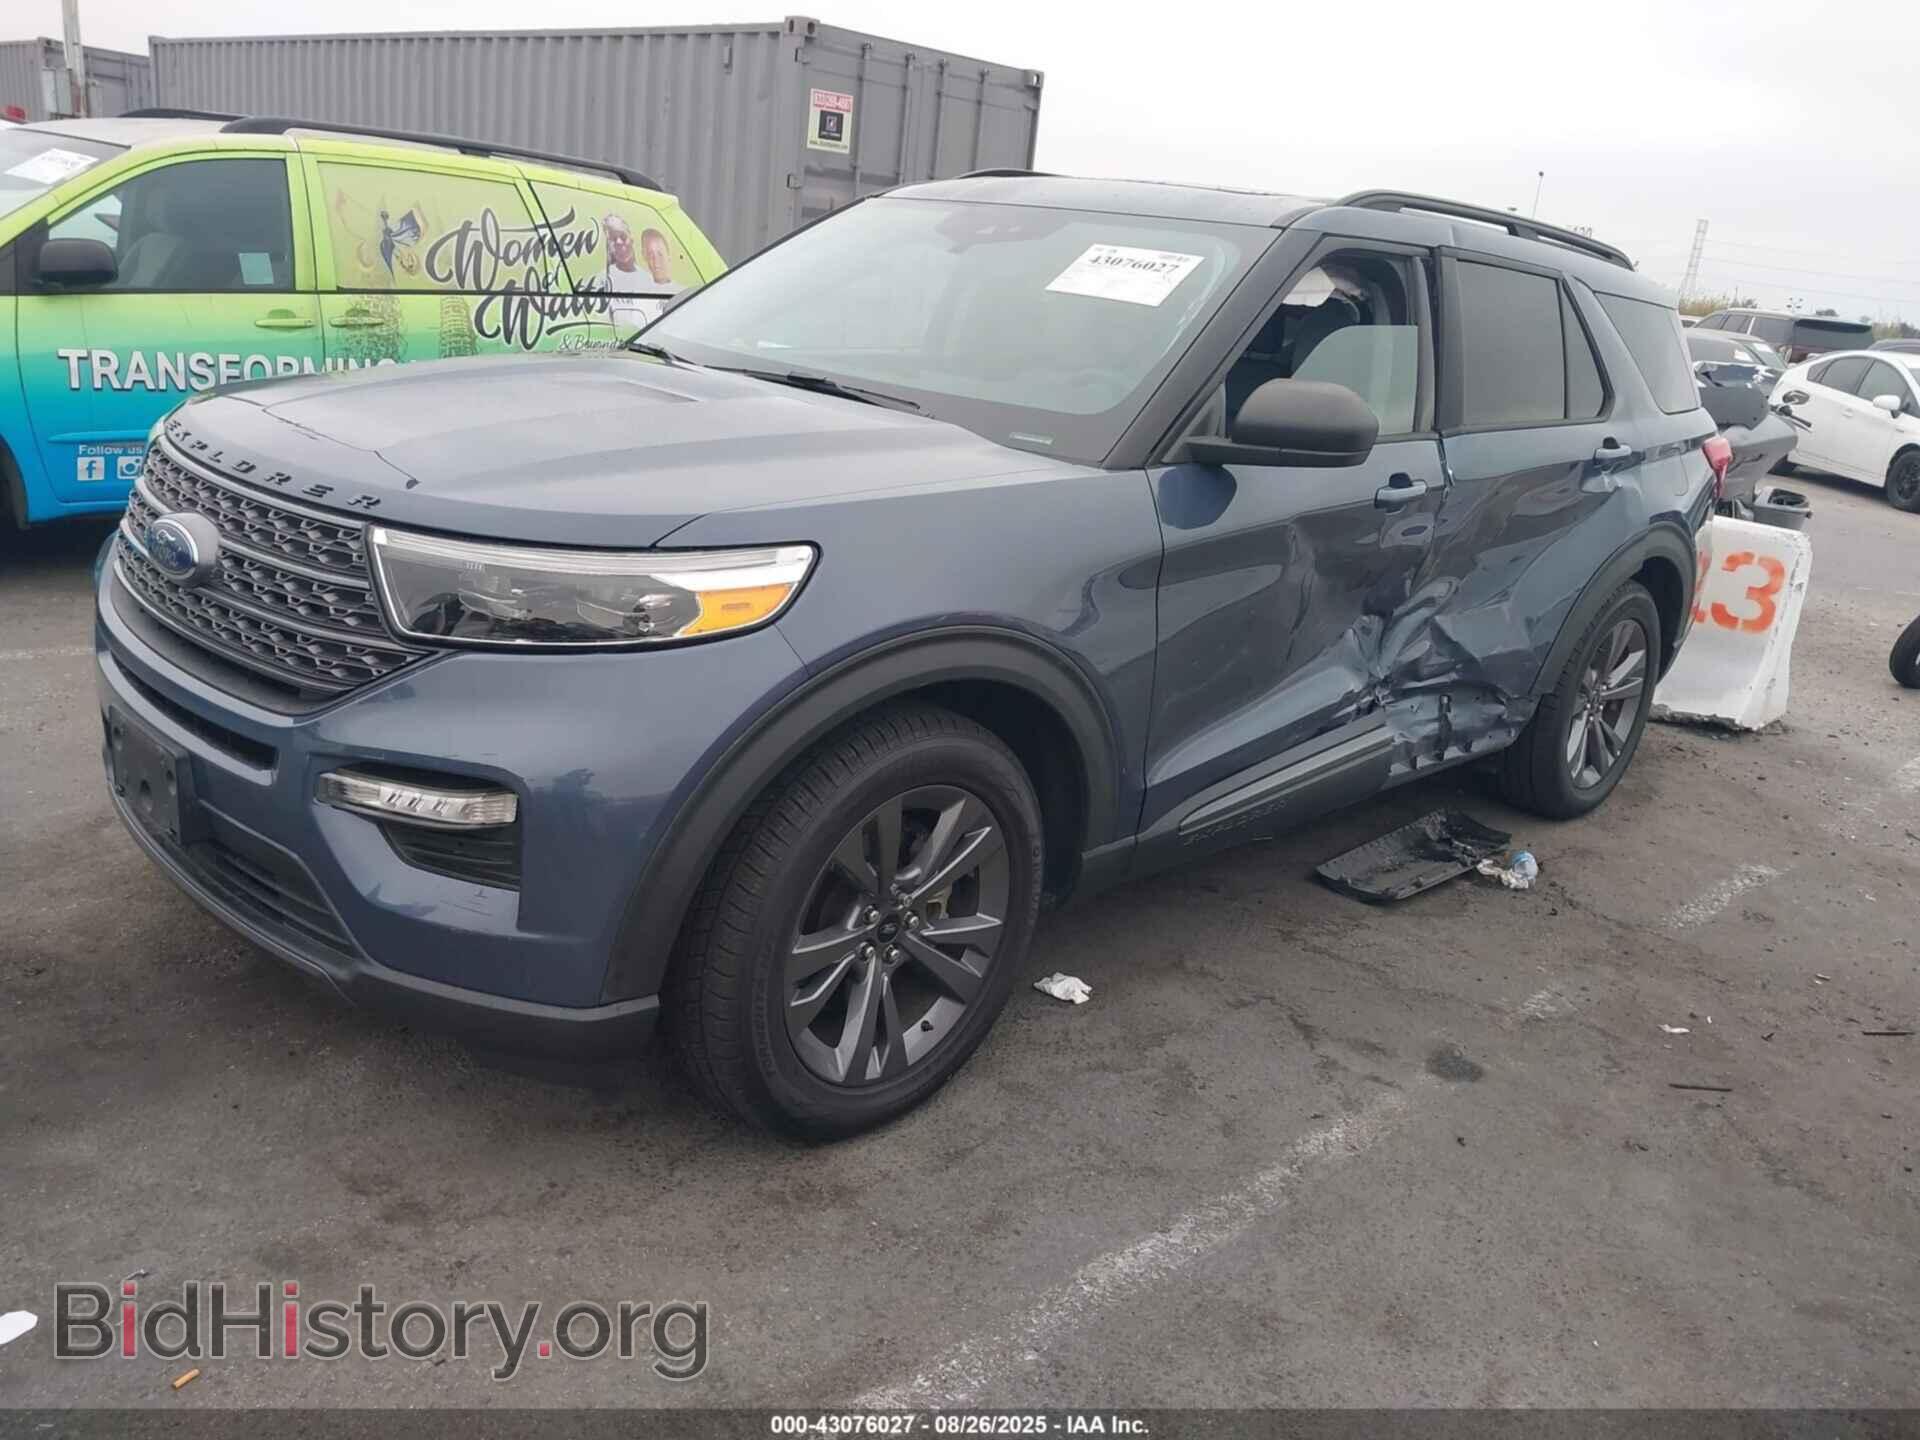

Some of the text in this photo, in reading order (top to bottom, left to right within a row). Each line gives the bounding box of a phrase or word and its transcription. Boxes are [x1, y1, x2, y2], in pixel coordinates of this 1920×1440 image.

[425, 207, 599, 290] Women
[1089, 255, 1180, 273] 43076027
[474, 266, 613, 350] Watts
[57, 349, 399, 391] TRANSFOR
[79, 445, 123, 455] Follow
[166, 420, 382, 509] EXPLORER
